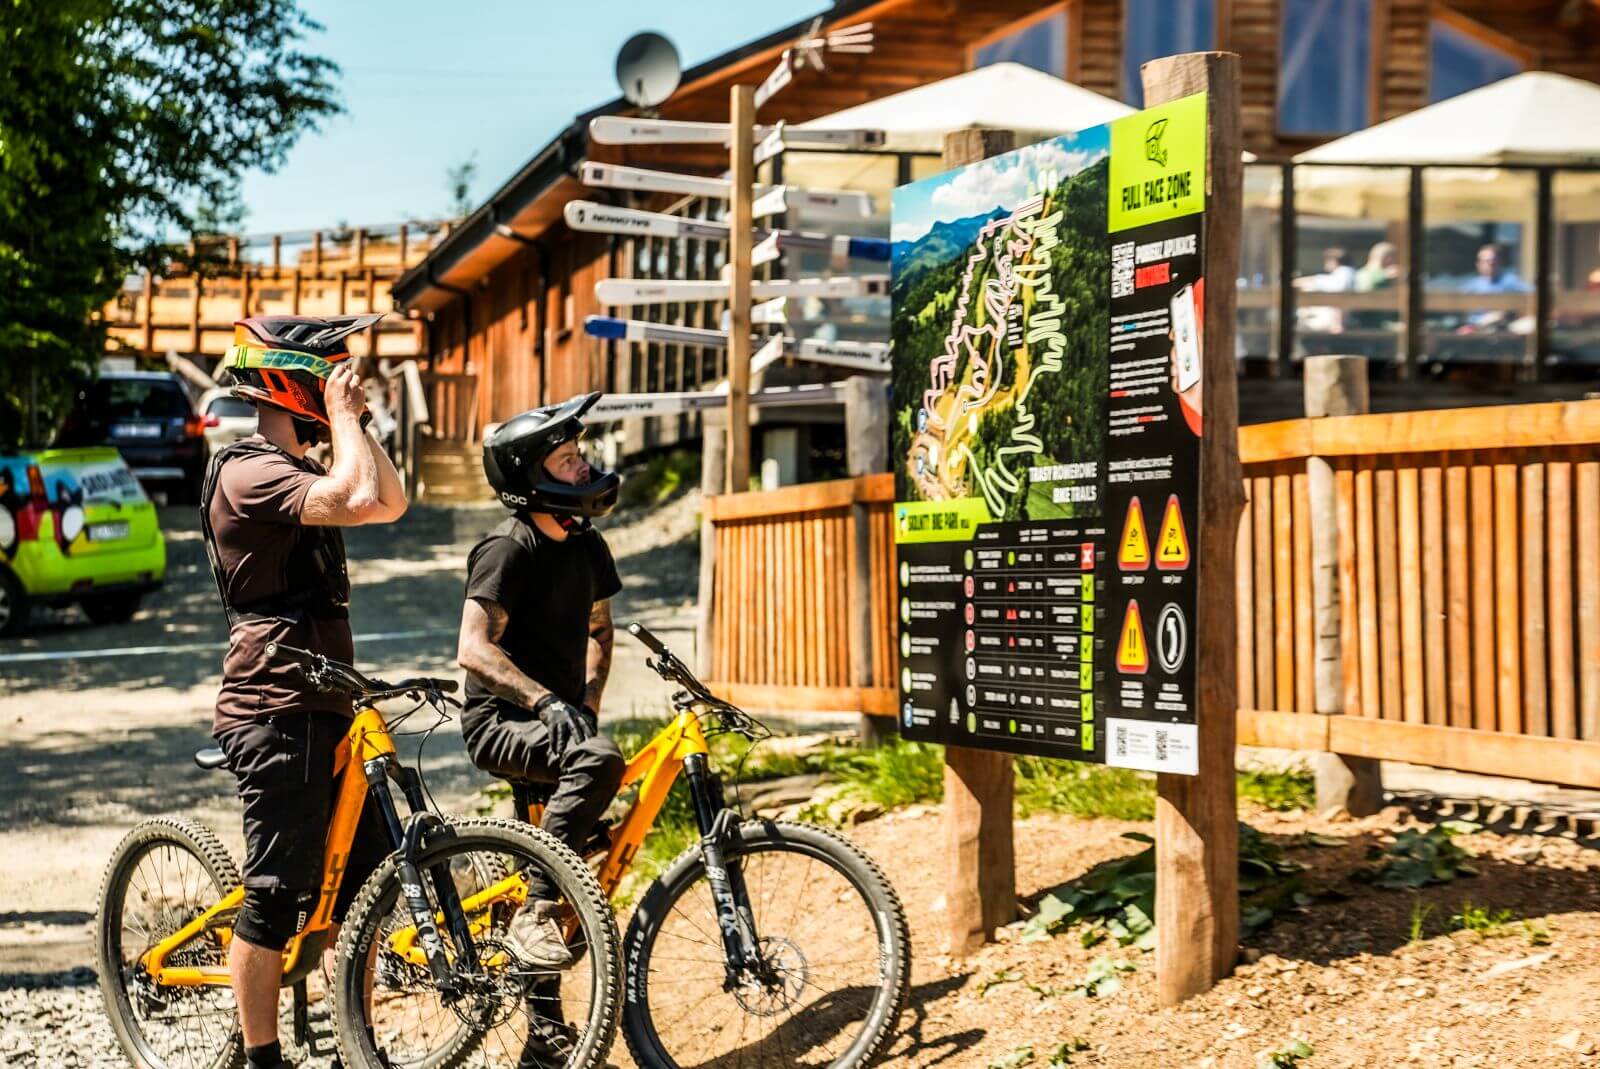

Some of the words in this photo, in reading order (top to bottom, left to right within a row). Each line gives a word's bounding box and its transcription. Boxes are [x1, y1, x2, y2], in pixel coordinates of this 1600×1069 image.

[1122, 184, 1141, 212] FULL
[1144, 178, 1165, 207] FACE
[1167, 170, 1191, 202] ZONE
[502, 491, 528, 506] POC
[344, 885, 382, 961] MAXXIS
[415, 909, 445, 960] FOX
[716, 892, 742, 937] FOX
[627, 929, 647, 1005] MAXXIS
